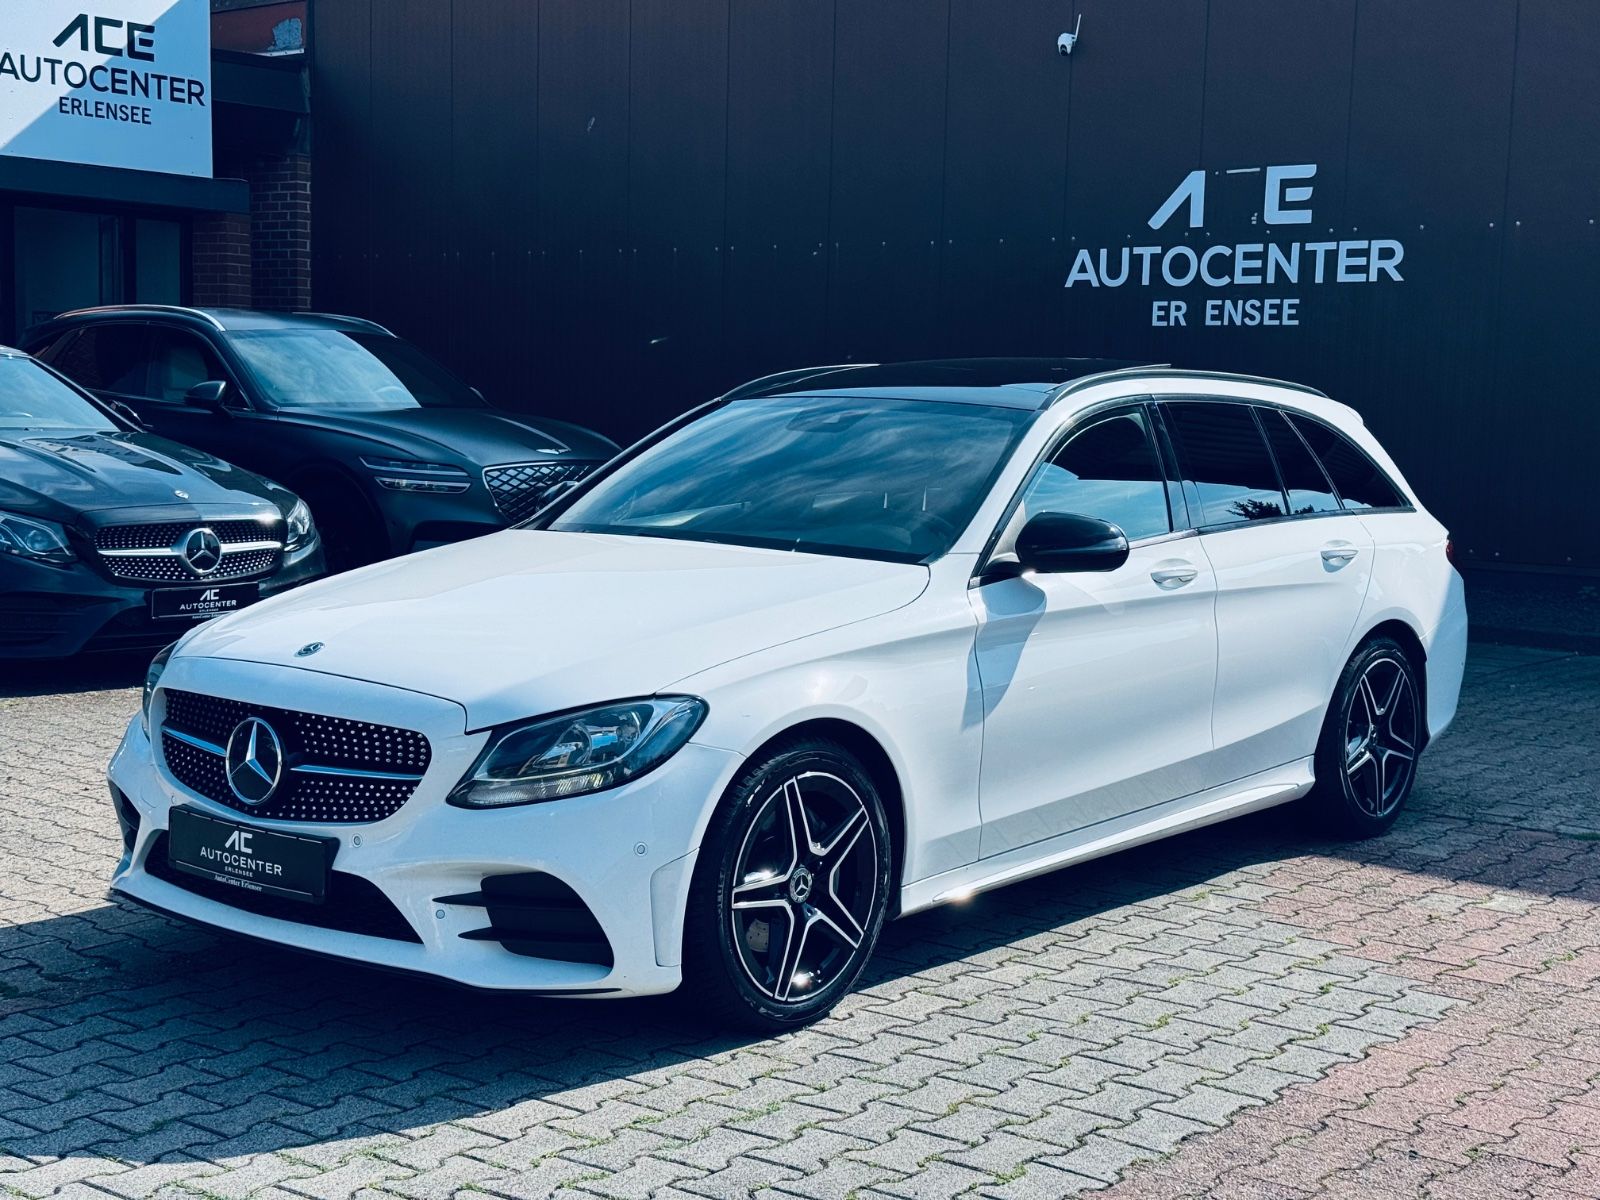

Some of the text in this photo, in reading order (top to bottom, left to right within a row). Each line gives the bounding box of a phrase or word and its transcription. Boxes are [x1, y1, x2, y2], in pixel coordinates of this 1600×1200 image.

[52, 13, 155, 62] ACE
[0, 52, 206, 106] AUTOCENTER
[59, 96, 152, 125] ERLENSEE
[1147, 164, 1317, 230] AE
[1064, 239, 1405, 288] AUTOCENTER
[179, 599, 237, 610] AUTOCENTER
[200, 846, 283, 876] AUTOCENTER
[224, 865, 253, 877] ERLENSEE
